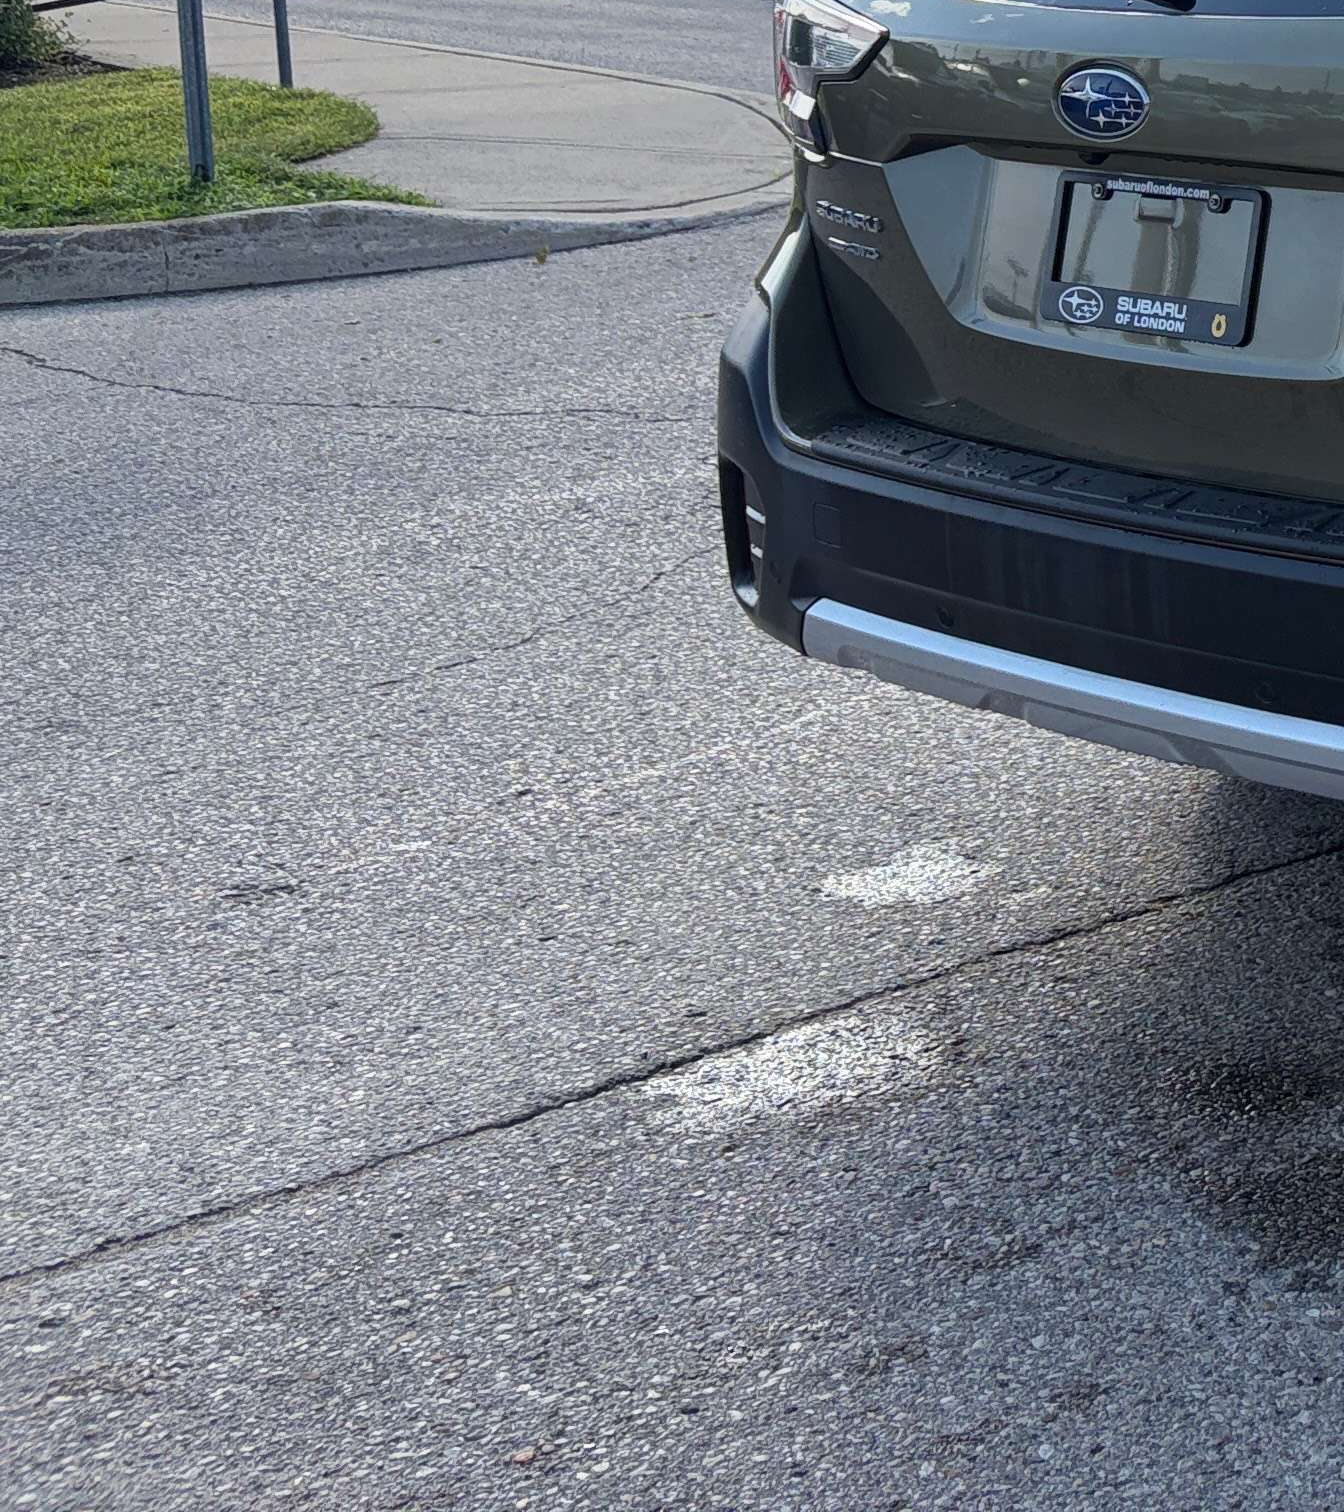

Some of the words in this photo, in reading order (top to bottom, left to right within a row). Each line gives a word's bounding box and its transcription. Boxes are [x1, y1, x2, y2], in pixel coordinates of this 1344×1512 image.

[1106, 178, 1210, 200] subaruoflondon.com
[1117, 295, 1188, 320] SUBARU
[1114, 313, 1131, 325] OF
[1133, 316, 1186, 333] LONDON
